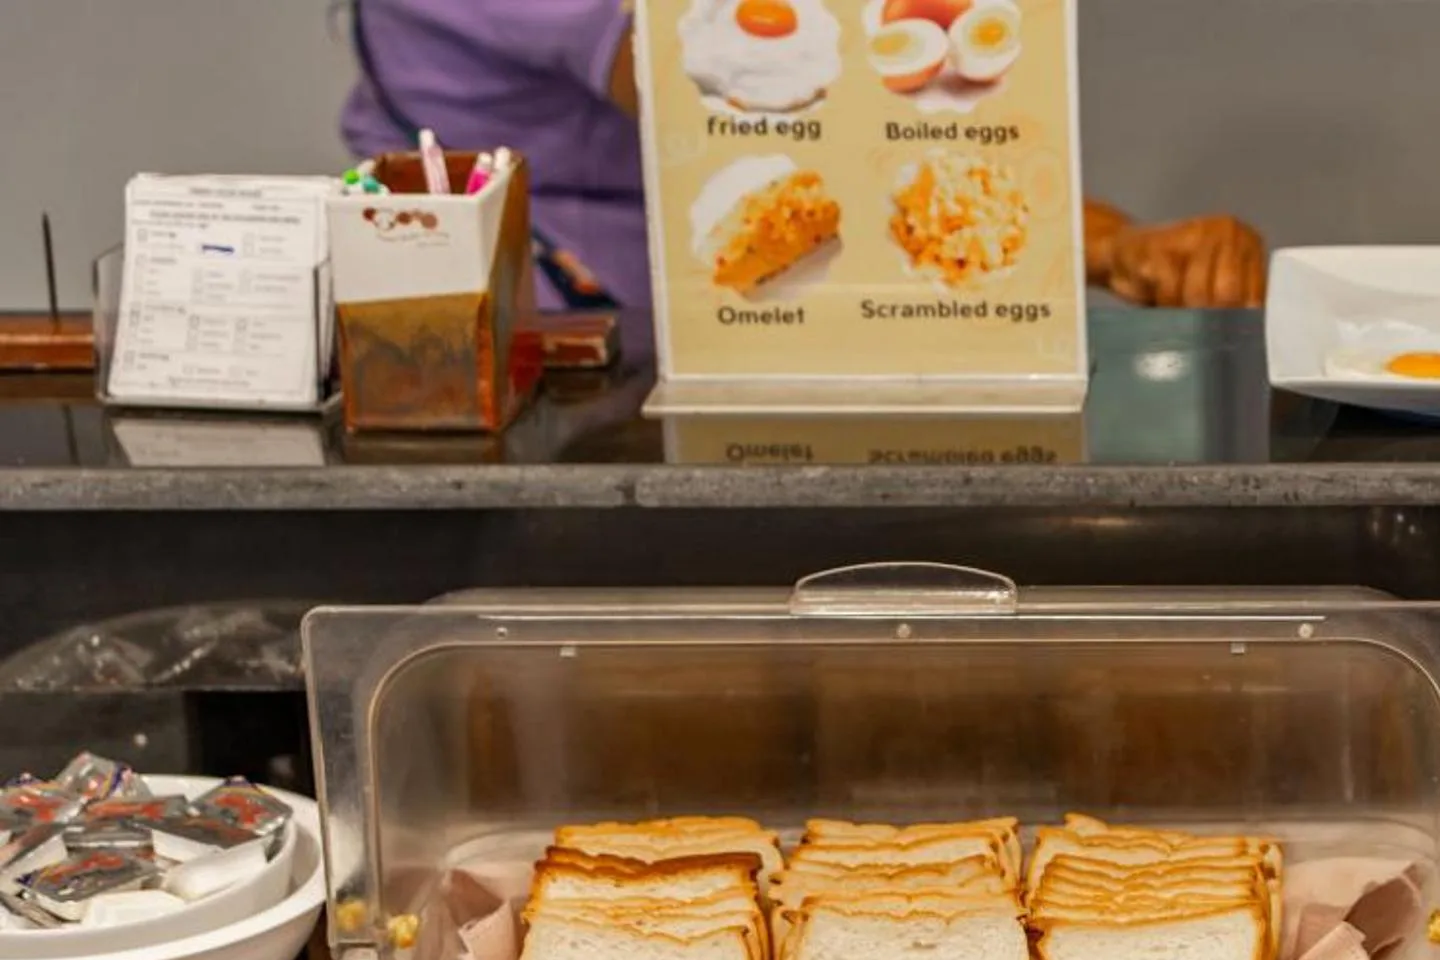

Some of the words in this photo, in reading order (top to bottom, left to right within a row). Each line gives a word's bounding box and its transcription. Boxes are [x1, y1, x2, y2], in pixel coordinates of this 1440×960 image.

[706, 116, 768, 137] fried
[775, 119, 822, 140] egg
[885, 121, 957, 142] Boiled
[963, 124, 1020, 144] eggs
[716, 306, 805, 326] Omelet
[860, 299, 988, 321] Scrambled
[994, 302, 1052, 324] eggs
